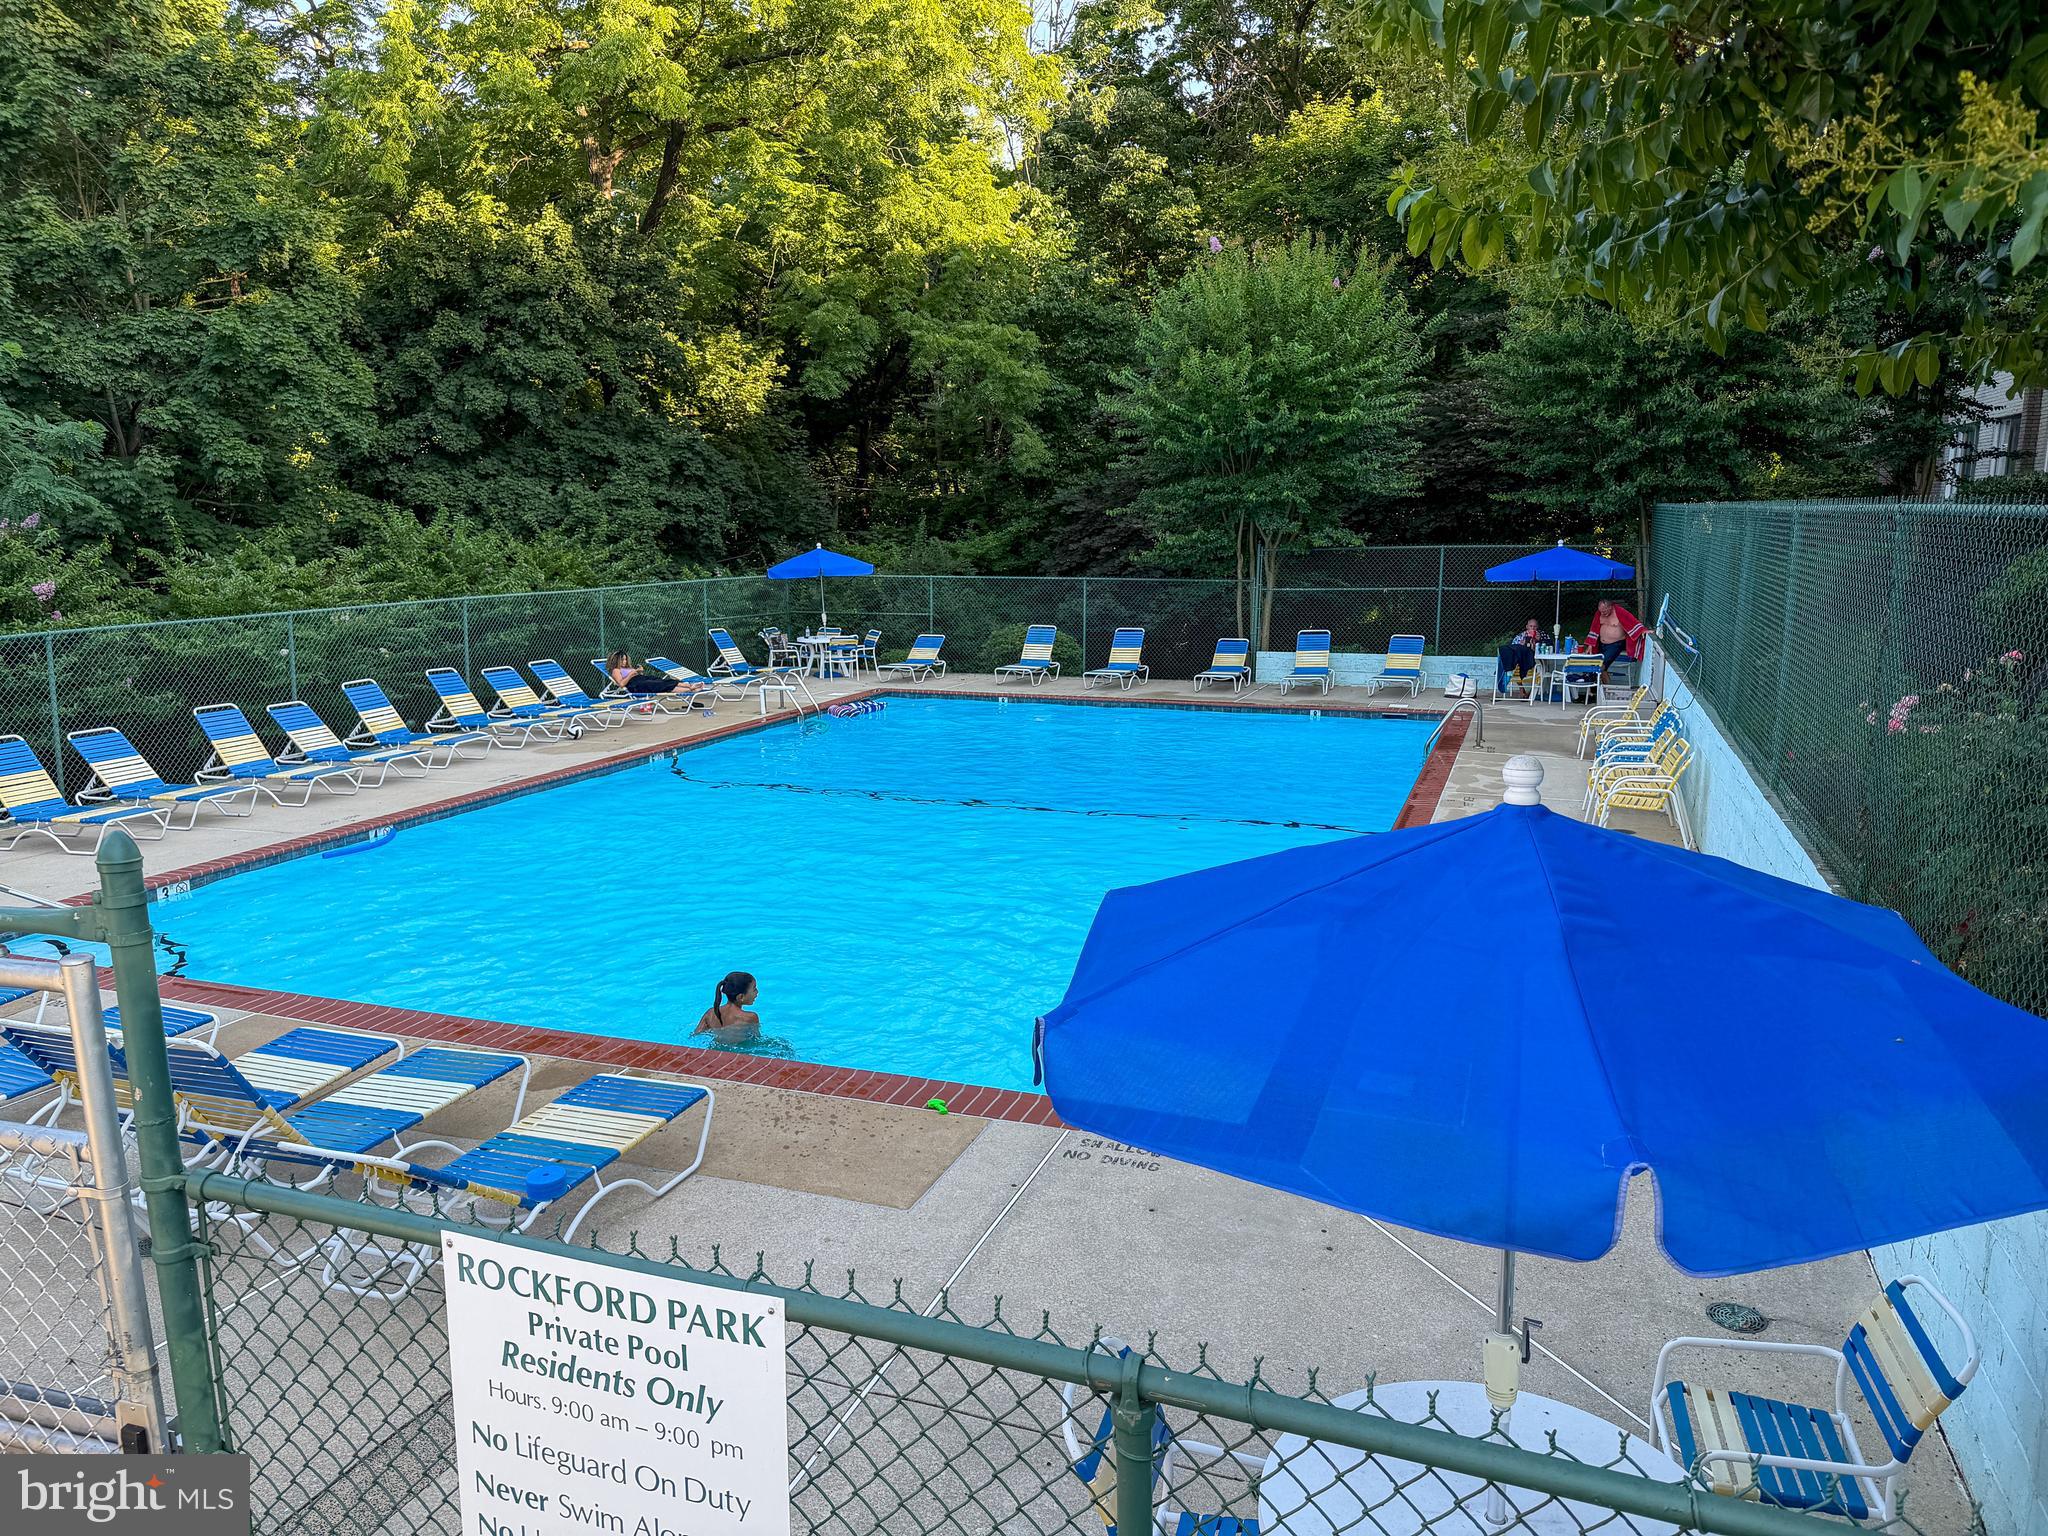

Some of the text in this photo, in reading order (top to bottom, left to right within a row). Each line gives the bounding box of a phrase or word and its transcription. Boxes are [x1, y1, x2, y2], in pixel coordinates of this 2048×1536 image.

[162, 887, 169, 899] 3
[1062, 1149, 1161, 1172] NO DIVING
[457, 1252, 767, 1349] ROCKFORD PARK
[528, 1311, 690, 1372] Private Pool
[501, 1340, 724, 1425] Residents Only
[551, 1396, 594, 1423] 9:00
[600, 1412, 630, 1432] am
[654, 1422, 701, 1449] 9:00
[711, 1439, 744, 1460] pm
[472, 1420, 752, 1522] No Lifeguard On Duty
[475, 1470, 549, 1512] Never
[558, 1494, 624, 1534] Swim
